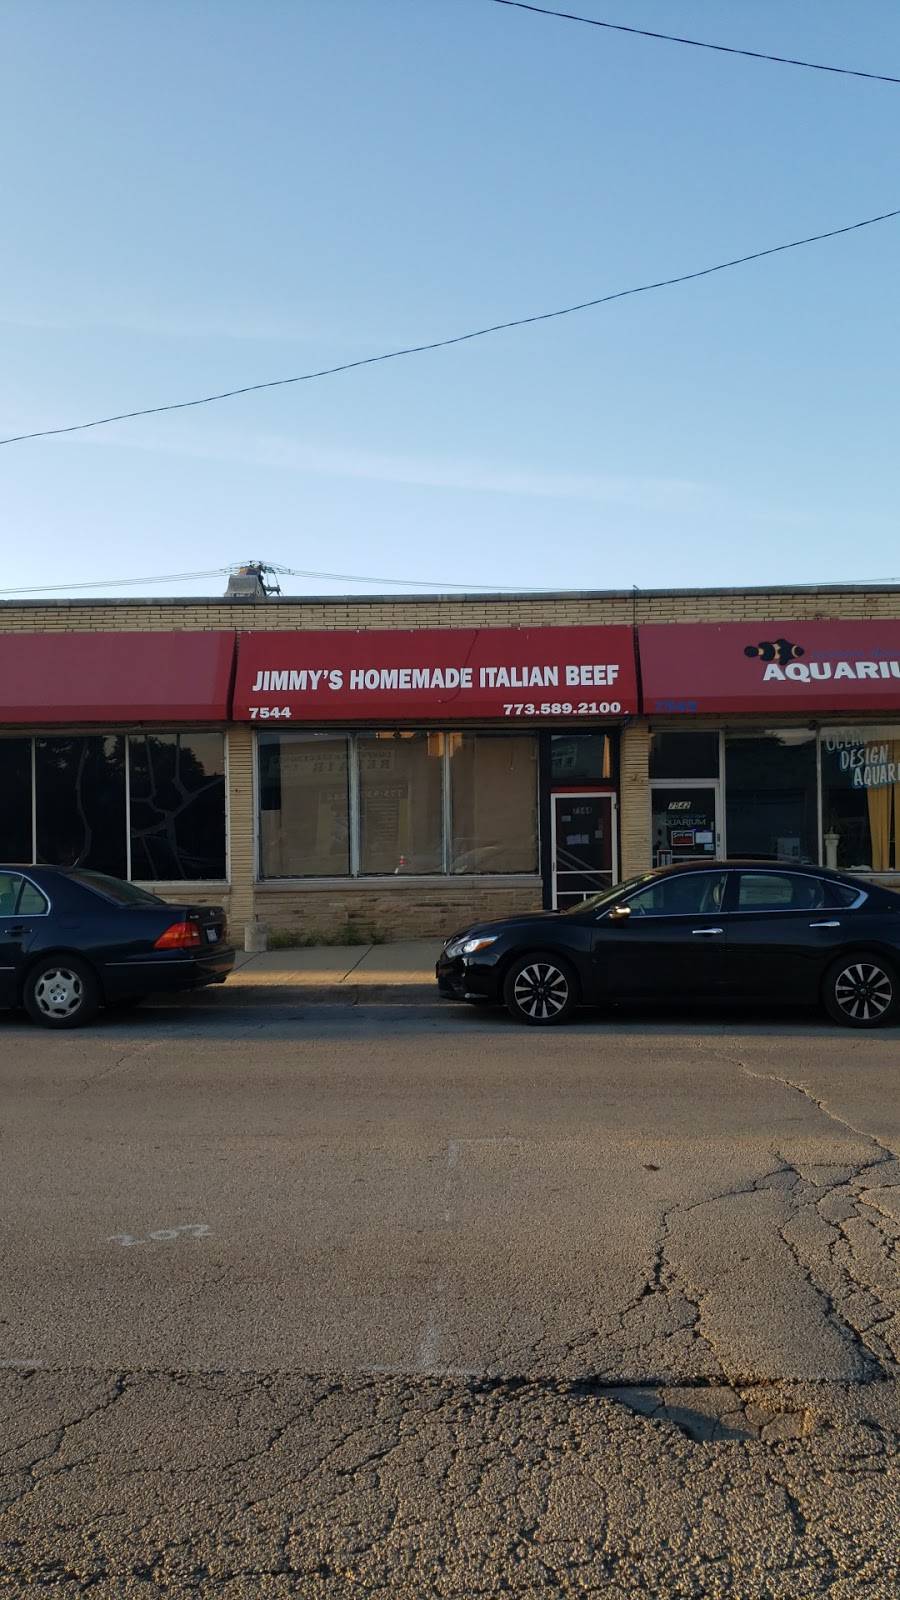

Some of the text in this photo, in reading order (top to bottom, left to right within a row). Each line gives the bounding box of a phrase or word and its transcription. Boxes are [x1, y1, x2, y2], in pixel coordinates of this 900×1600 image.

[252, 664, 620, 692] JIMMY'S HOMEMADE ITALIAN BEEF
[248, 706, 292, 719] 7544
[503, 701, 621, 716] 773.589.2100
[841, 744, 889, 770] DESIGN
